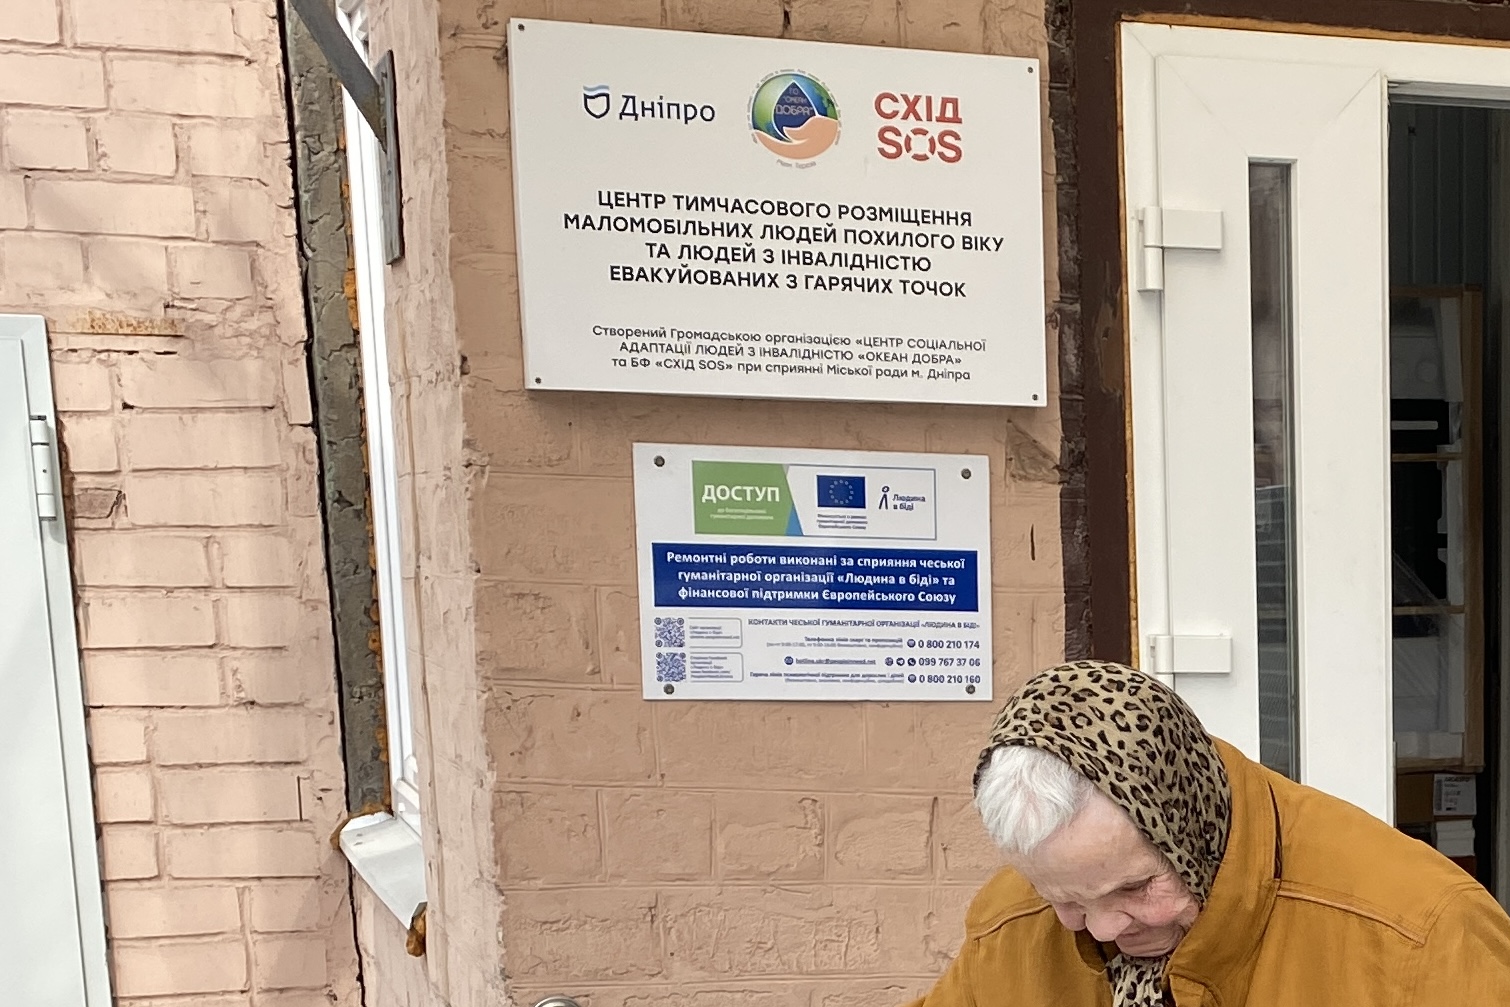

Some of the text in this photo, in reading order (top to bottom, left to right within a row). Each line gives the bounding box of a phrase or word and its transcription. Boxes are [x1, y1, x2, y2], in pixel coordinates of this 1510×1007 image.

[619, 94, 716, 125] Дніпро
[874, 92, 963, 124] СХІД
[877, 125, 962, 163] SOS
[597, 190, 972, 227] ЦЕНТР ТИМЧАСОВОГО РОЗМІЩЕННЯ
[564, 213, 1004, 252] МАЛОМОБІЛЬНИХ ЛЮДЕЙ ПОХИЛОГО ВІКУ
[645, 242, 931, 272] ТА ЛЮДЕЙ З ІНВАЛІДНІСТЮ
[610, 263, 966, 298] ЕВАКУЙОВАНИХ З ГАРЯЧИХ ТОЧОК
[592, 325, 987, 351] Створений Громадською організацією «ЦЕНТР СОЦІАЛЬНОЇ
[619, 340, 962, 365] АДАПТАЦІЇ ЛЮДЕЙ З ІНВАЛІДНІСТЮ «ОКЕАН ДОБРА»
[612, 358, 627, 368] та
[631, 357, 651, 368] БФ
[655, 358, 695, 371] «СХІД
[698, 359, 733, 371] SOS»
[737, 363, 762, 374] при
[765, 362, 823, 376] сприянні
[827, 364, 873, 376] Міської
[876, 367, 908, 379] ради
[927, 368, 971, 382] Дніпра
[702, 485, 780, 504] ДОСТУП
[667, 551, 966, 569] Ремонтні роботи виконані за сприяння чеської
[678, 570, 955, 587] гуманітарної організації «Людина в біді» та
[678, 586, 957, 605] фінансової підтримки Європейського Союзу
[748, 618, 788, 626] КОНТАКТИ
[918, 640, 980, 649] 0 800 210 174
[919, 657, 936, 666] 099
[938, 657, 954, 666] 767
[956, 658, 966, 666] 37
[919, 675, 981, 684] 0 800 210 160
